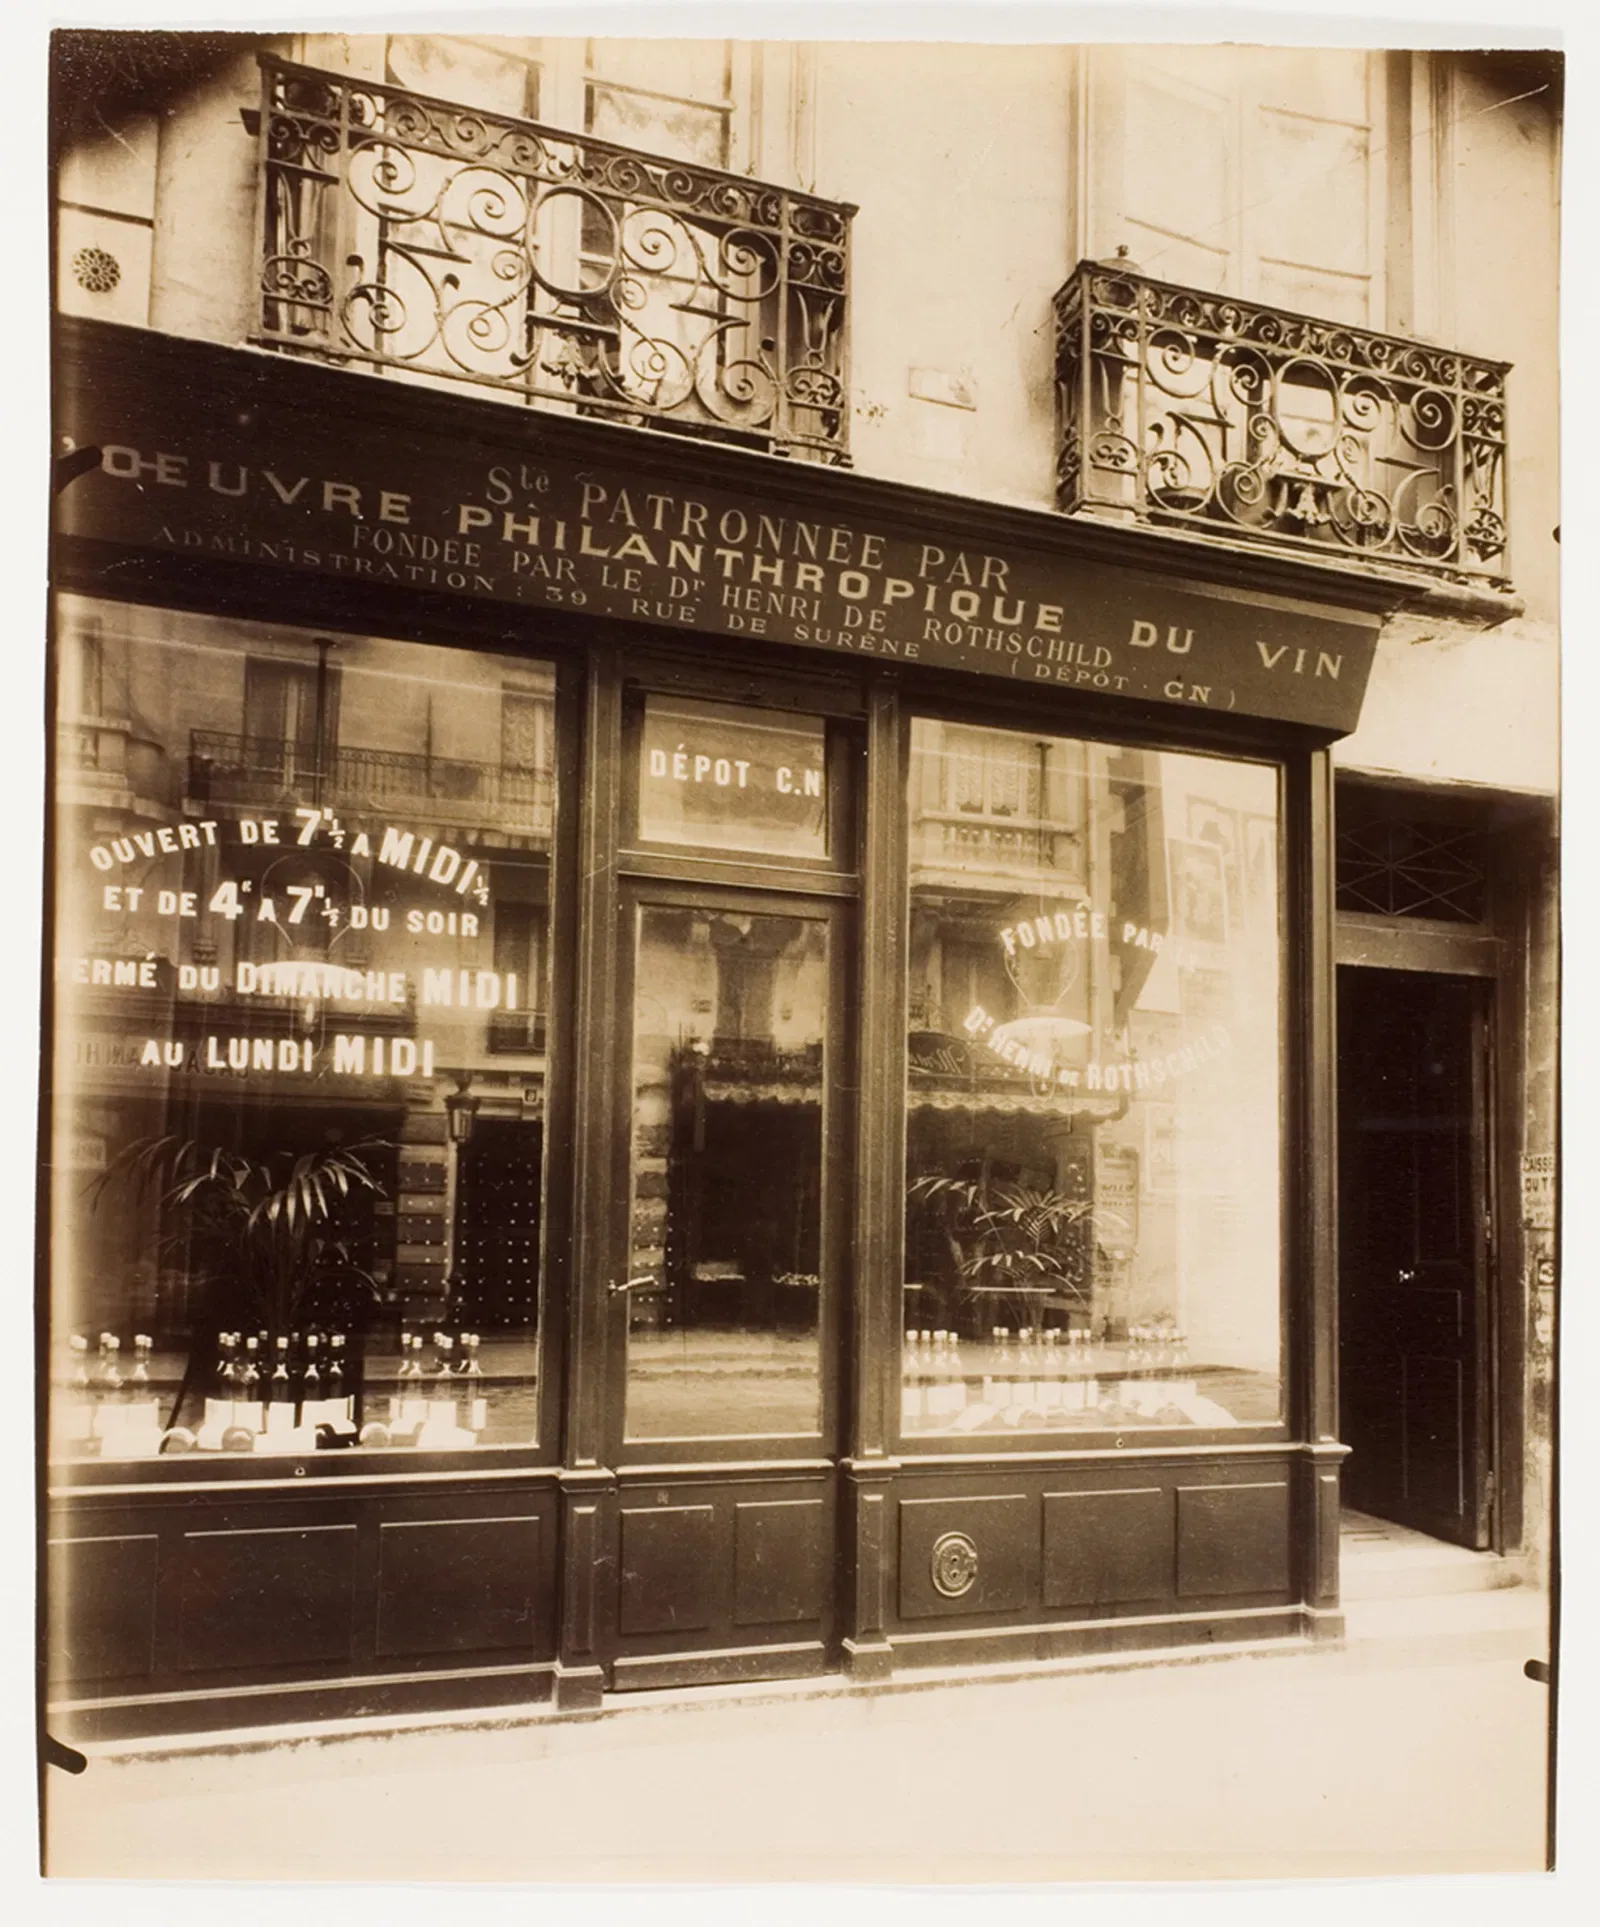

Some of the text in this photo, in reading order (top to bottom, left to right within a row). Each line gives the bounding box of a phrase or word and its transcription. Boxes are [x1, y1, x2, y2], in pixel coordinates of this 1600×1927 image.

[580, 480, 888, 572] PATRONNÉE
[918, 544, 1010, 594] PAR
[152, 525, 497, 593] ADMINISTRATION
[545, 585, 589, 606] 39
[631, 598, 697, 624] RUE
[727, 613, 767, 634] DE
[457, 503, 1065, 633] PHILANTHROPIQUE
[1128, 619, 1196, 654] DU
[1255, 640, 1344, 681] VIN
[512, 551, 577, 583] PAR
[602, 564, 642, 592] LE
[722, 584, 821, 622] HENRI
[843, 604, 888, 634] DE
[922, 617, 1113, 669] ROTHSCHILD
[650, 743, 751, 788] DÉPOT
[89, 820, 219, 871] OUVERT
[240, 820, 280, 845] DE
[350, 832, 371, 858] A
[378, 826, 479, 896] MIDI
[104, 886, 144, 911] ET
[158, 891, 198, 916] DE
[256, 897, 277, 922] A
[351, 907, 390, 931] DU
[406, 910, 480, 937] SOIR
[1121, 920, 1166, 952] PAR
[178, 965, 220, 991] DU
[236, 961, 406, 1003] DIMANCHE
[423, 968, 518, 1010] MIDI
[141, 1040, 184, 1067] AU
[207, 1035, 313, 1074] LUNDI
[333, 1035, 436, 1078] MIDI
[1085, 1024, 1233, 1093] ROTHSCHILD
